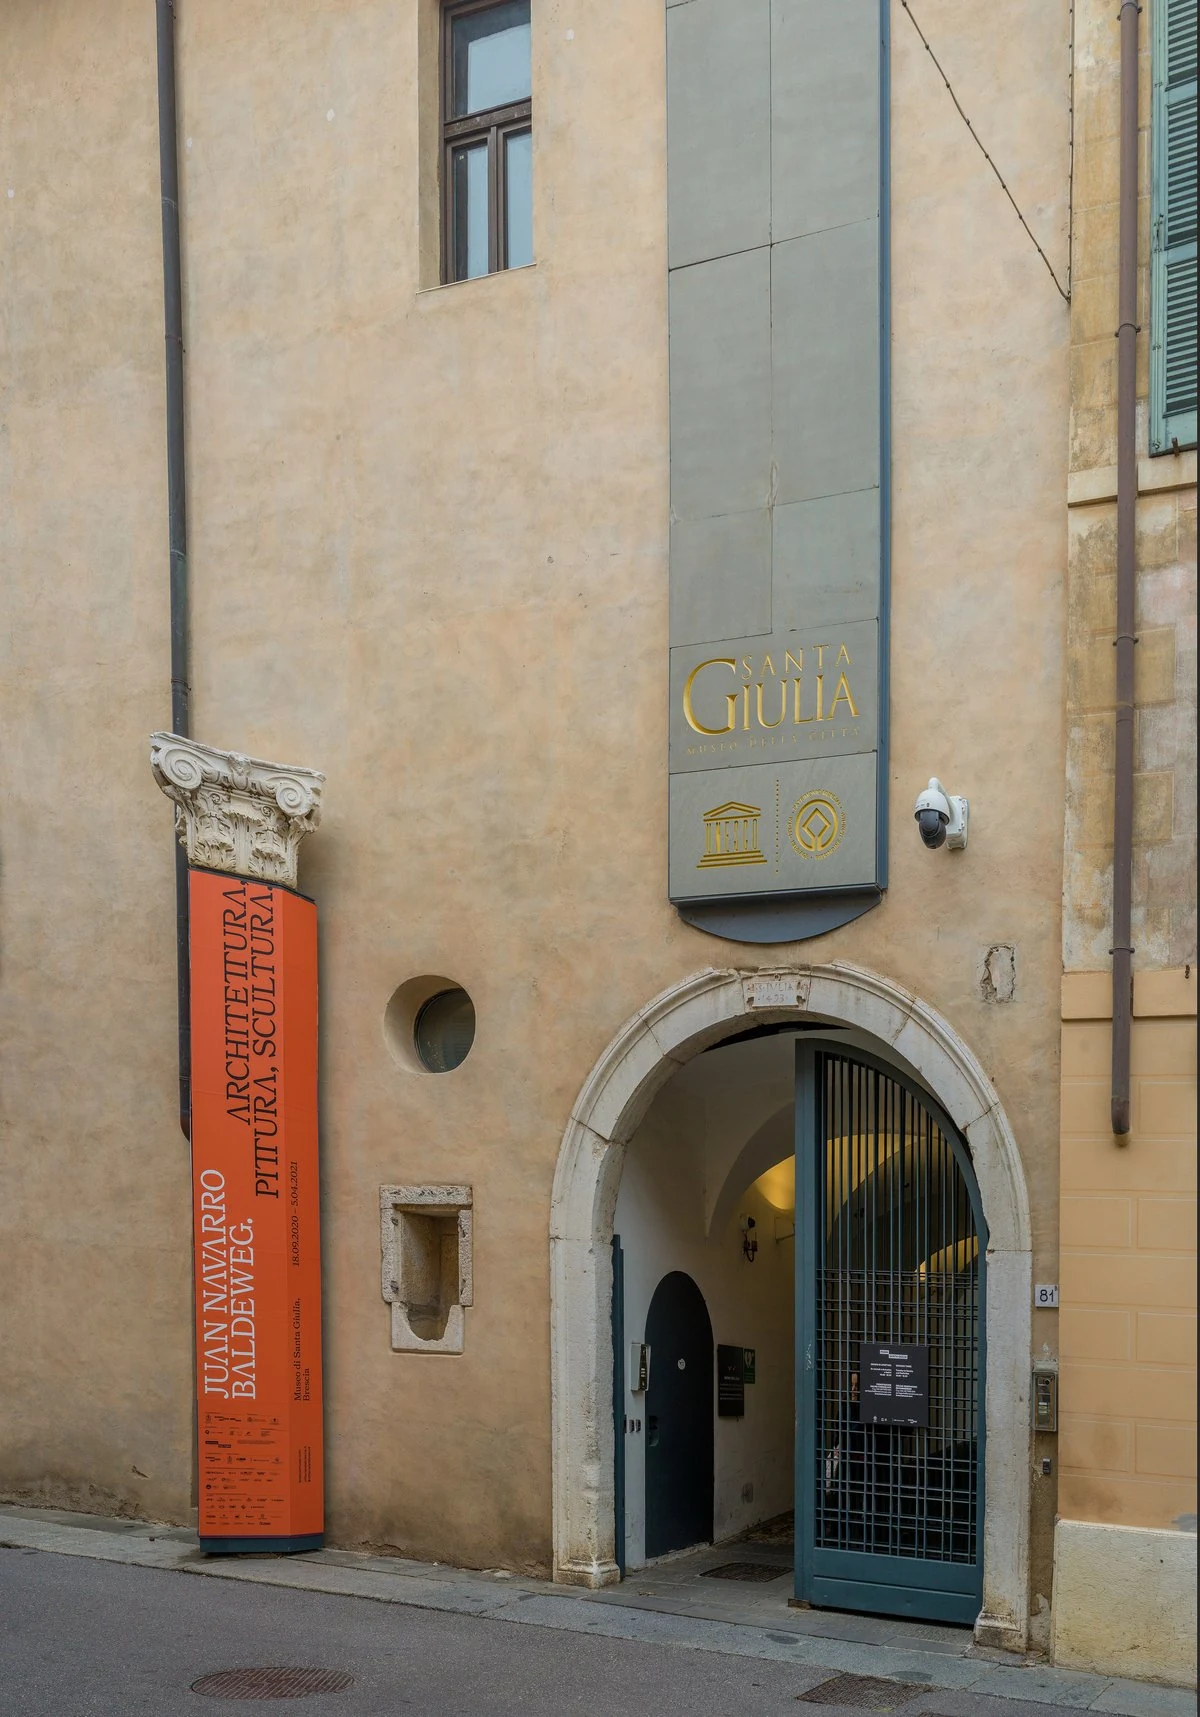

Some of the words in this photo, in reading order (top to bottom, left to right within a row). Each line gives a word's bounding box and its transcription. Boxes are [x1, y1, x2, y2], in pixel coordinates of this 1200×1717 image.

[682, 658, 861, 736] GIULIA
[741, 641, 852, 680] SANTA
[222, 880, 250, 1126] ARCHITETTURA,
[249, 886, 277, 1058] SCULTURA.
[253, 1066, 280, 1199] PITTURA,
[290, 1161, 299, 1207] 5.04.2021
[200, 1169, 228, 1314] NAVARRO
[291, 1215, 300, 1268] 18.09.2020
[229, 1218, 256, 1400] BALDEWEG.
[293, 1298, 302, 1330] Giulia,
[293, 1331, 301, 1359] Santa
[203, 1319, 229, 1399] JUAN
[293, 1360, 301, 1370] di
